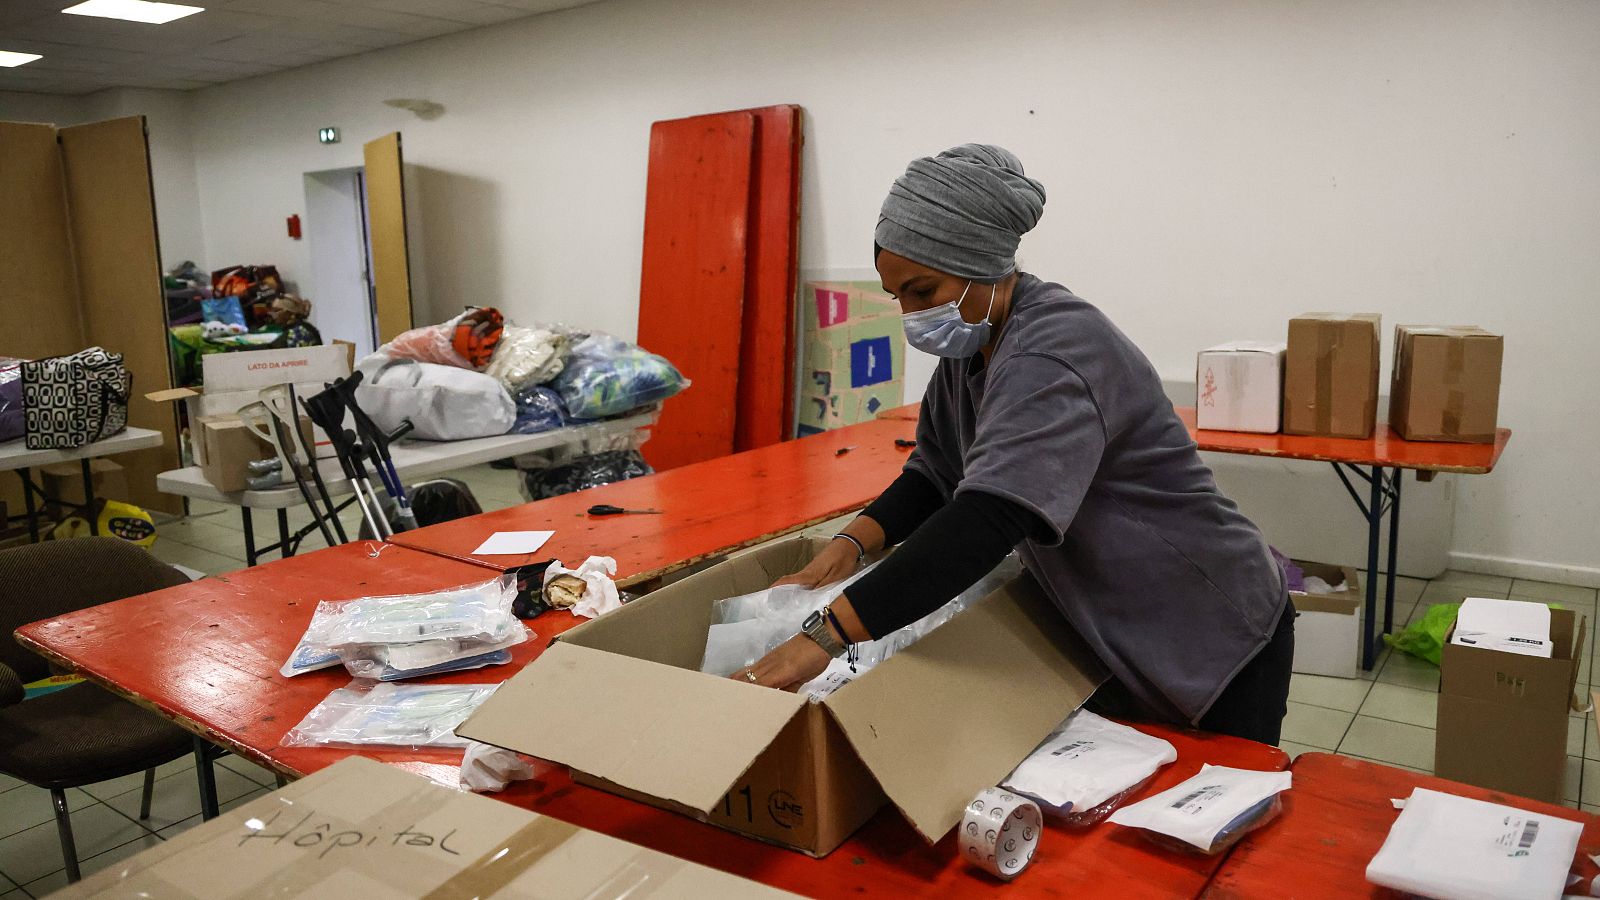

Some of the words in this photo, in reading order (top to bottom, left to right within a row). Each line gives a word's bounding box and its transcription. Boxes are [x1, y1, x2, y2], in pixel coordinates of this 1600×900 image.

[247, 362, 267, 371] LATO
[269, 361, 280, 369] DA
[238, 810, 460, 860] Hôpital
